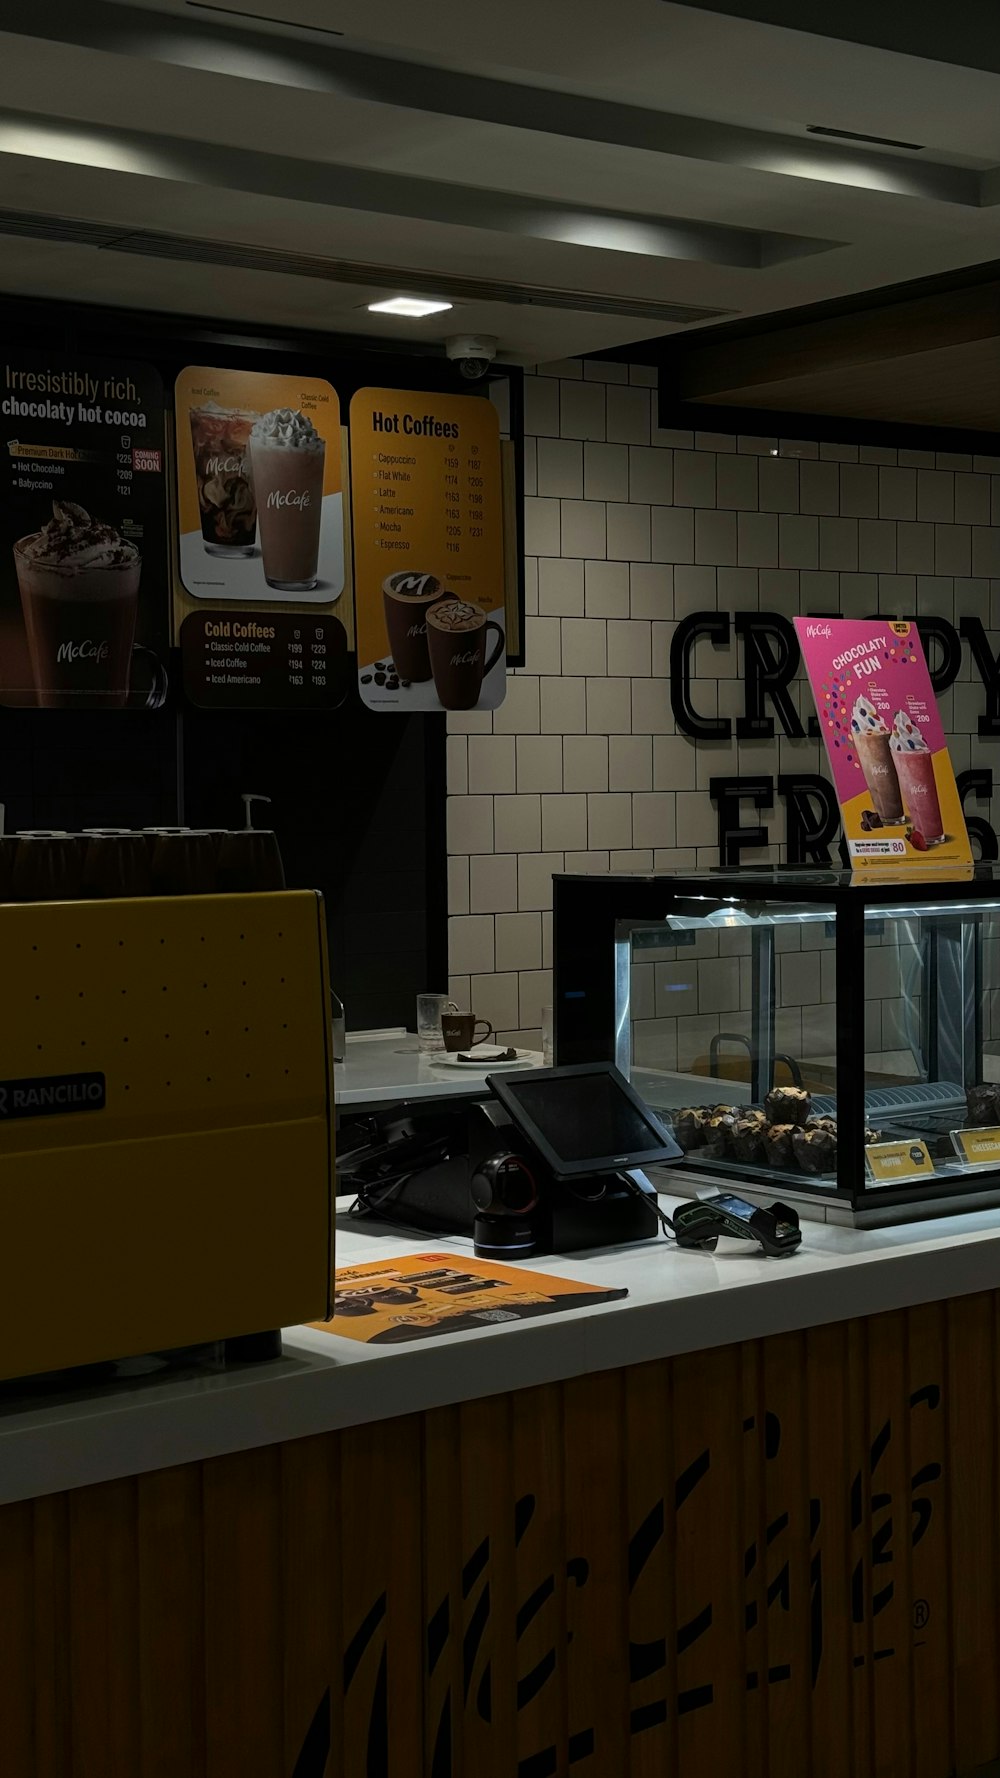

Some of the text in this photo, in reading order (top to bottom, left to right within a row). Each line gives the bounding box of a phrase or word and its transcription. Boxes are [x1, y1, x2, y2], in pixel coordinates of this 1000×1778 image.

[6, 365, 142, 405] Irresistibly rich,
[2, 395, 147, 428] chocolaty hot cocoa
[372, 411, 459, 439] Hot Coffees
[49, 448, 64, 458] Dark
[134, 451, 159, 460] COMING
[378, 452, 417, 466] Cappuccino
[17, 462, 65, 475] Hot Chocolate
[134, 460, 160, 471] SOON
[206, 456, 247, 477] McCaf
[378, 471, 391, 480] Flat
[392, 473, 411, 481] White
[18, 478, 53, 491] Babyccino
[379, 488, 396, 498] Latte
[266, 489, 311, 512] McCafé
[379, 504, 414, 516] Americano
[380, 521, 402, 532] Mocha
[380, 538, 410, 551] Espresso
[204, 621, 275, 639] Cold Coffees
[806, 624, 832, 639] McCafé
[56, 639, 109, 665] McCafé
[210, 642, 234, 652] Classic
[234, 643, 249, 653] Cold
[249, 643, 271, 653] Coffee
[832, 637, 887, 671] CHOCOLATY
[210, 658, 225, 668] Iced
[225, 658, 248, 669] Coffee
[853, 656, 882, 680] FUN
[211, 675, 226, 684] Iced
[226, 675, 261, 685] Americano
[13, 1082, 103, 1109] RANCILIO
